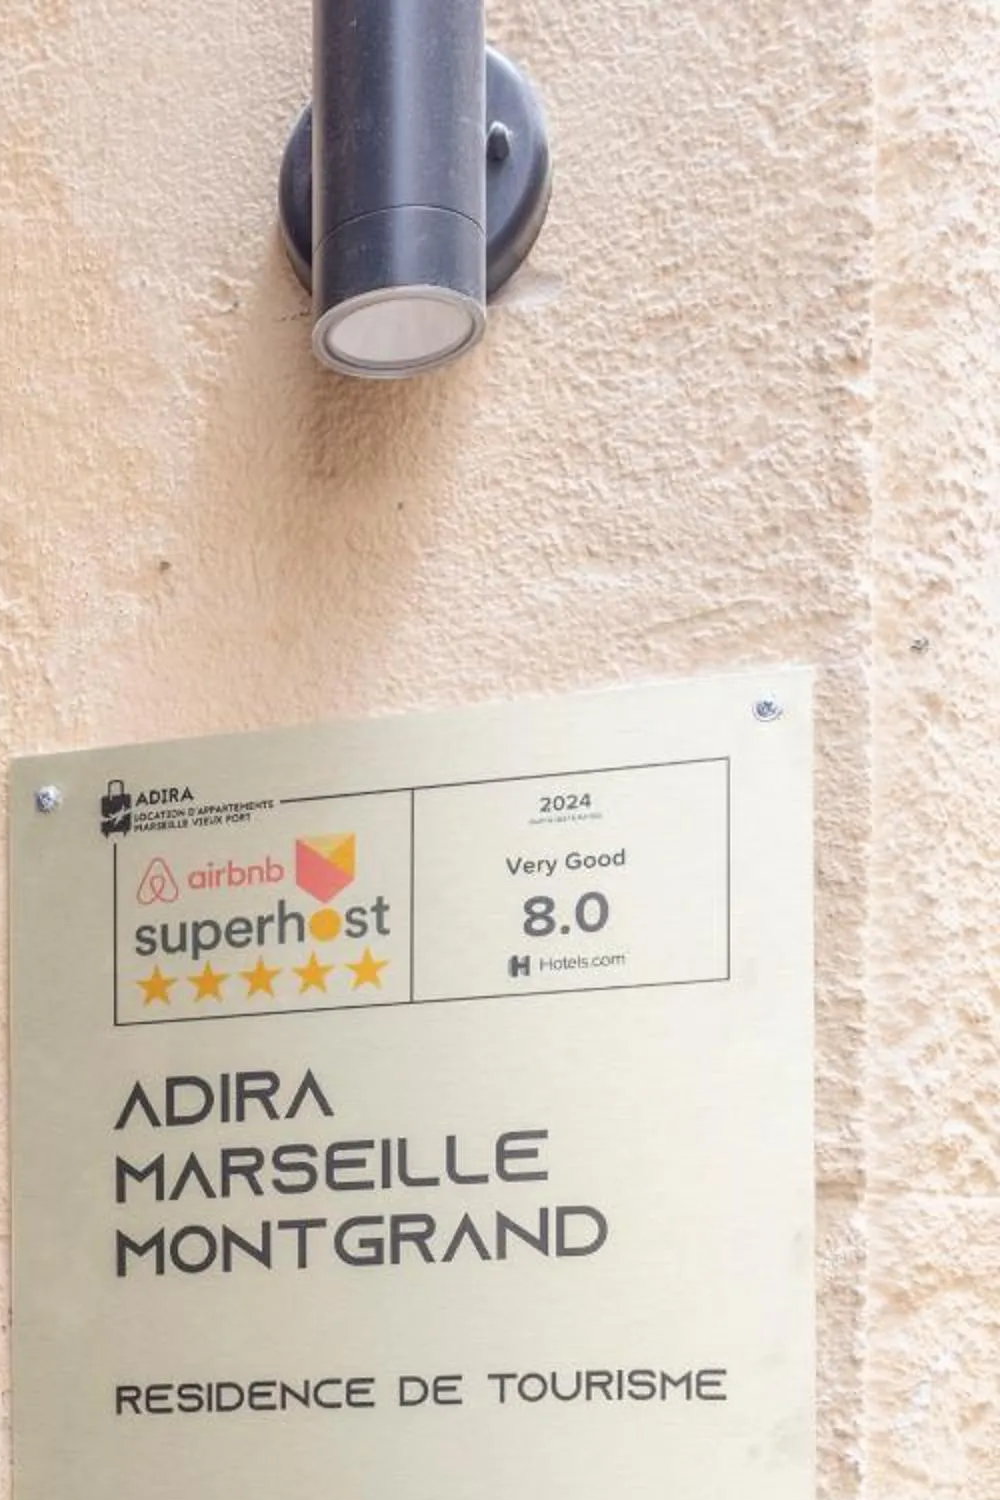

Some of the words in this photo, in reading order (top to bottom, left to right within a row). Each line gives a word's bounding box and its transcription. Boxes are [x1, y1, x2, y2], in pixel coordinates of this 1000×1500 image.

[135, 786, 194, 806] ADIRA
[539, 793, 592, 813] 2024
[133, 820, 189, 832] MARSEILLE
[191, 815, 222, 826] VIEUX
[225, 813, 251, 823] PORT
[134, 810, 185, 822] LOCATION
[187, 857, 285, 889] airbnb
[506, 857, 558, 877] Very
[565, 848, 626, 870] Good
[523, 891, 609, 937] 8.0
[539, 954, 626, 971] Hotels.com
[113, 1068, 335, 1130] ADIRA
[114, 1129, 549, 1203] MARSEILLE
[115, 1205, 608, 1278] MONTGRAND
[115, 1378, 376, 1415] RESIDENCE
[399, 1375, 463, 1406] DE
[487, 1369, 727, 1404] TOURISME
